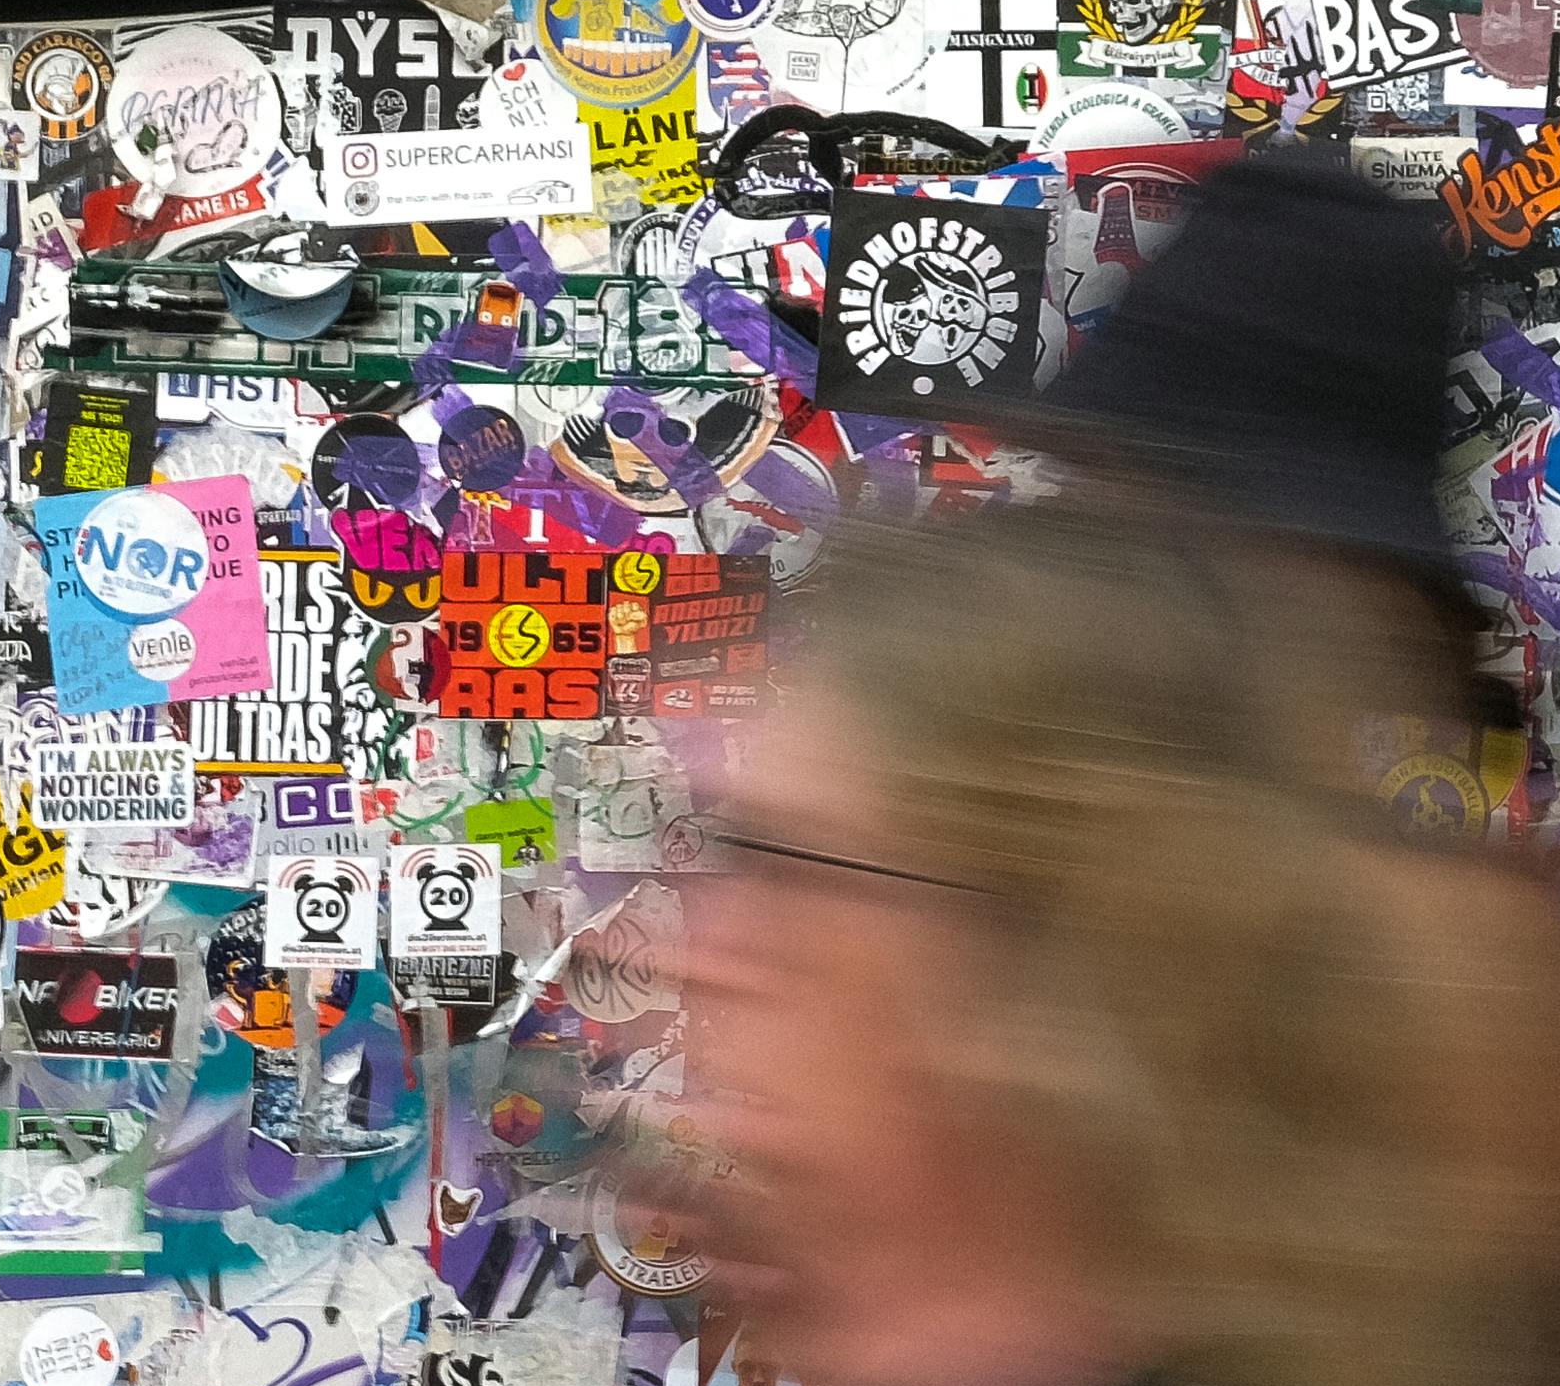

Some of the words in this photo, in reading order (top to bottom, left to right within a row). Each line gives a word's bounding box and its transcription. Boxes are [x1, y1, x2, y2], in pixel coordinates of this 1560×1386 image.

[949, 31, 1036, 48] MASIGNANO
[385, 141, 574, 169] SUPERCARHANSI
[442, 557, 601, 604] ULT
[447, 622, 481, 652] 19
[552, 622, 599, 652] 65
[440, 672, 602, 718] RAS
[190, 702, 334, 764] ULTRAS
[40, 750, 78, 773] I'M
[85, 748, 186, 773] ALWAYS
[38, 775, 163, 799] NOTICING
[168, 775, 187, 797] &
[38, 798, 188, 824] WONDERING
[309, 898, 341, 919] 20
[429, 886, 466, 908] 20
